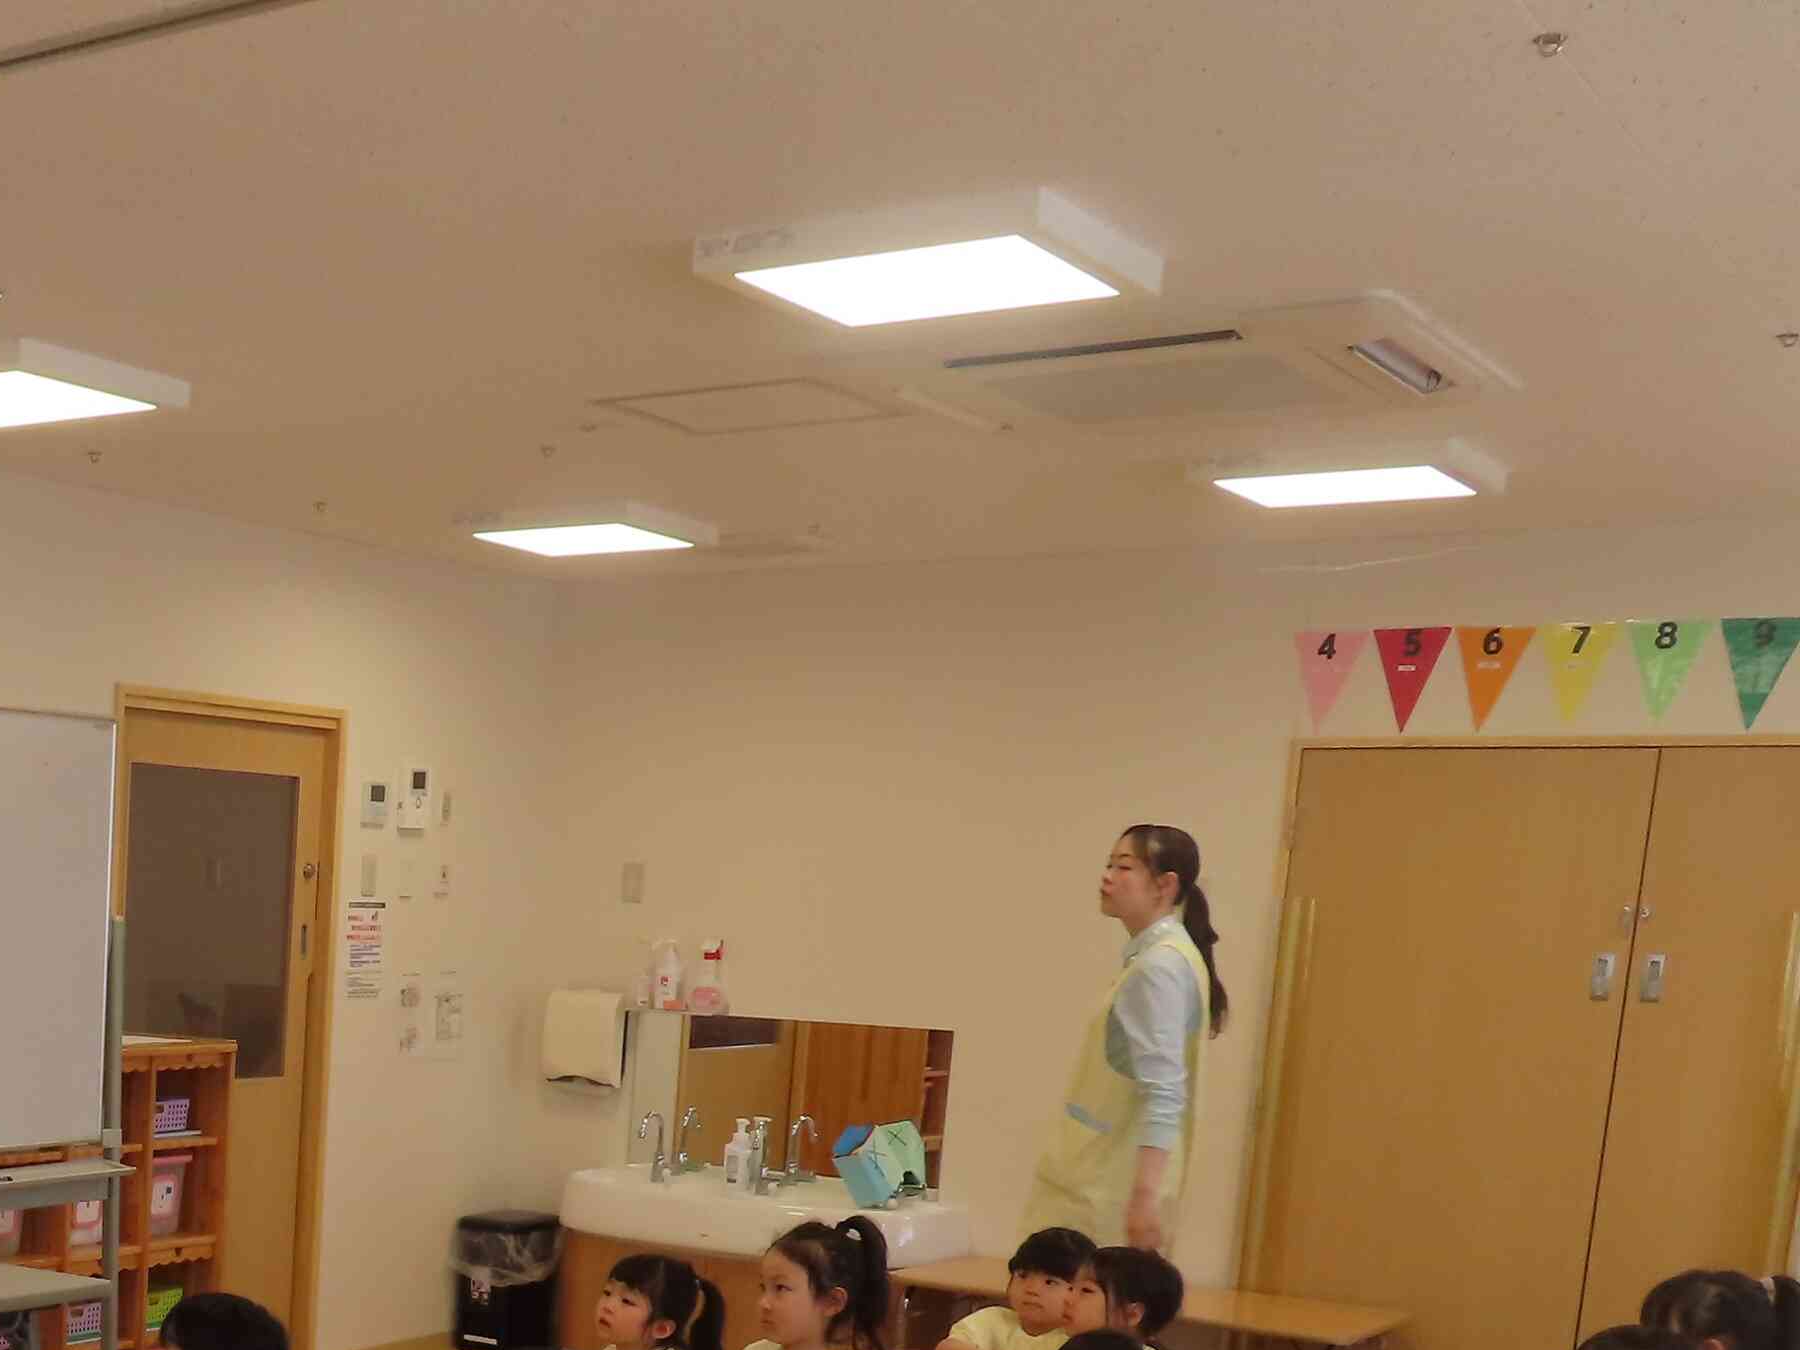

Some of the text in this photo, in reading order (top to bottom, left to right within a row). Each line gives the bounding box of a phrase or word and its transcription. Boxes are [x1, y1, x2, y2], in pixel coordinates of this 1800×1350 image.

[1317, 633, 1337, 660] 4
[1403, 629, 1422, 657] 5
[1483, 628, 1504, 655] 6
[1570, 626, 1592, 654] 7
[1654, 621, 1678, 649] 8
[1753, 619, 1777, 647] 9
